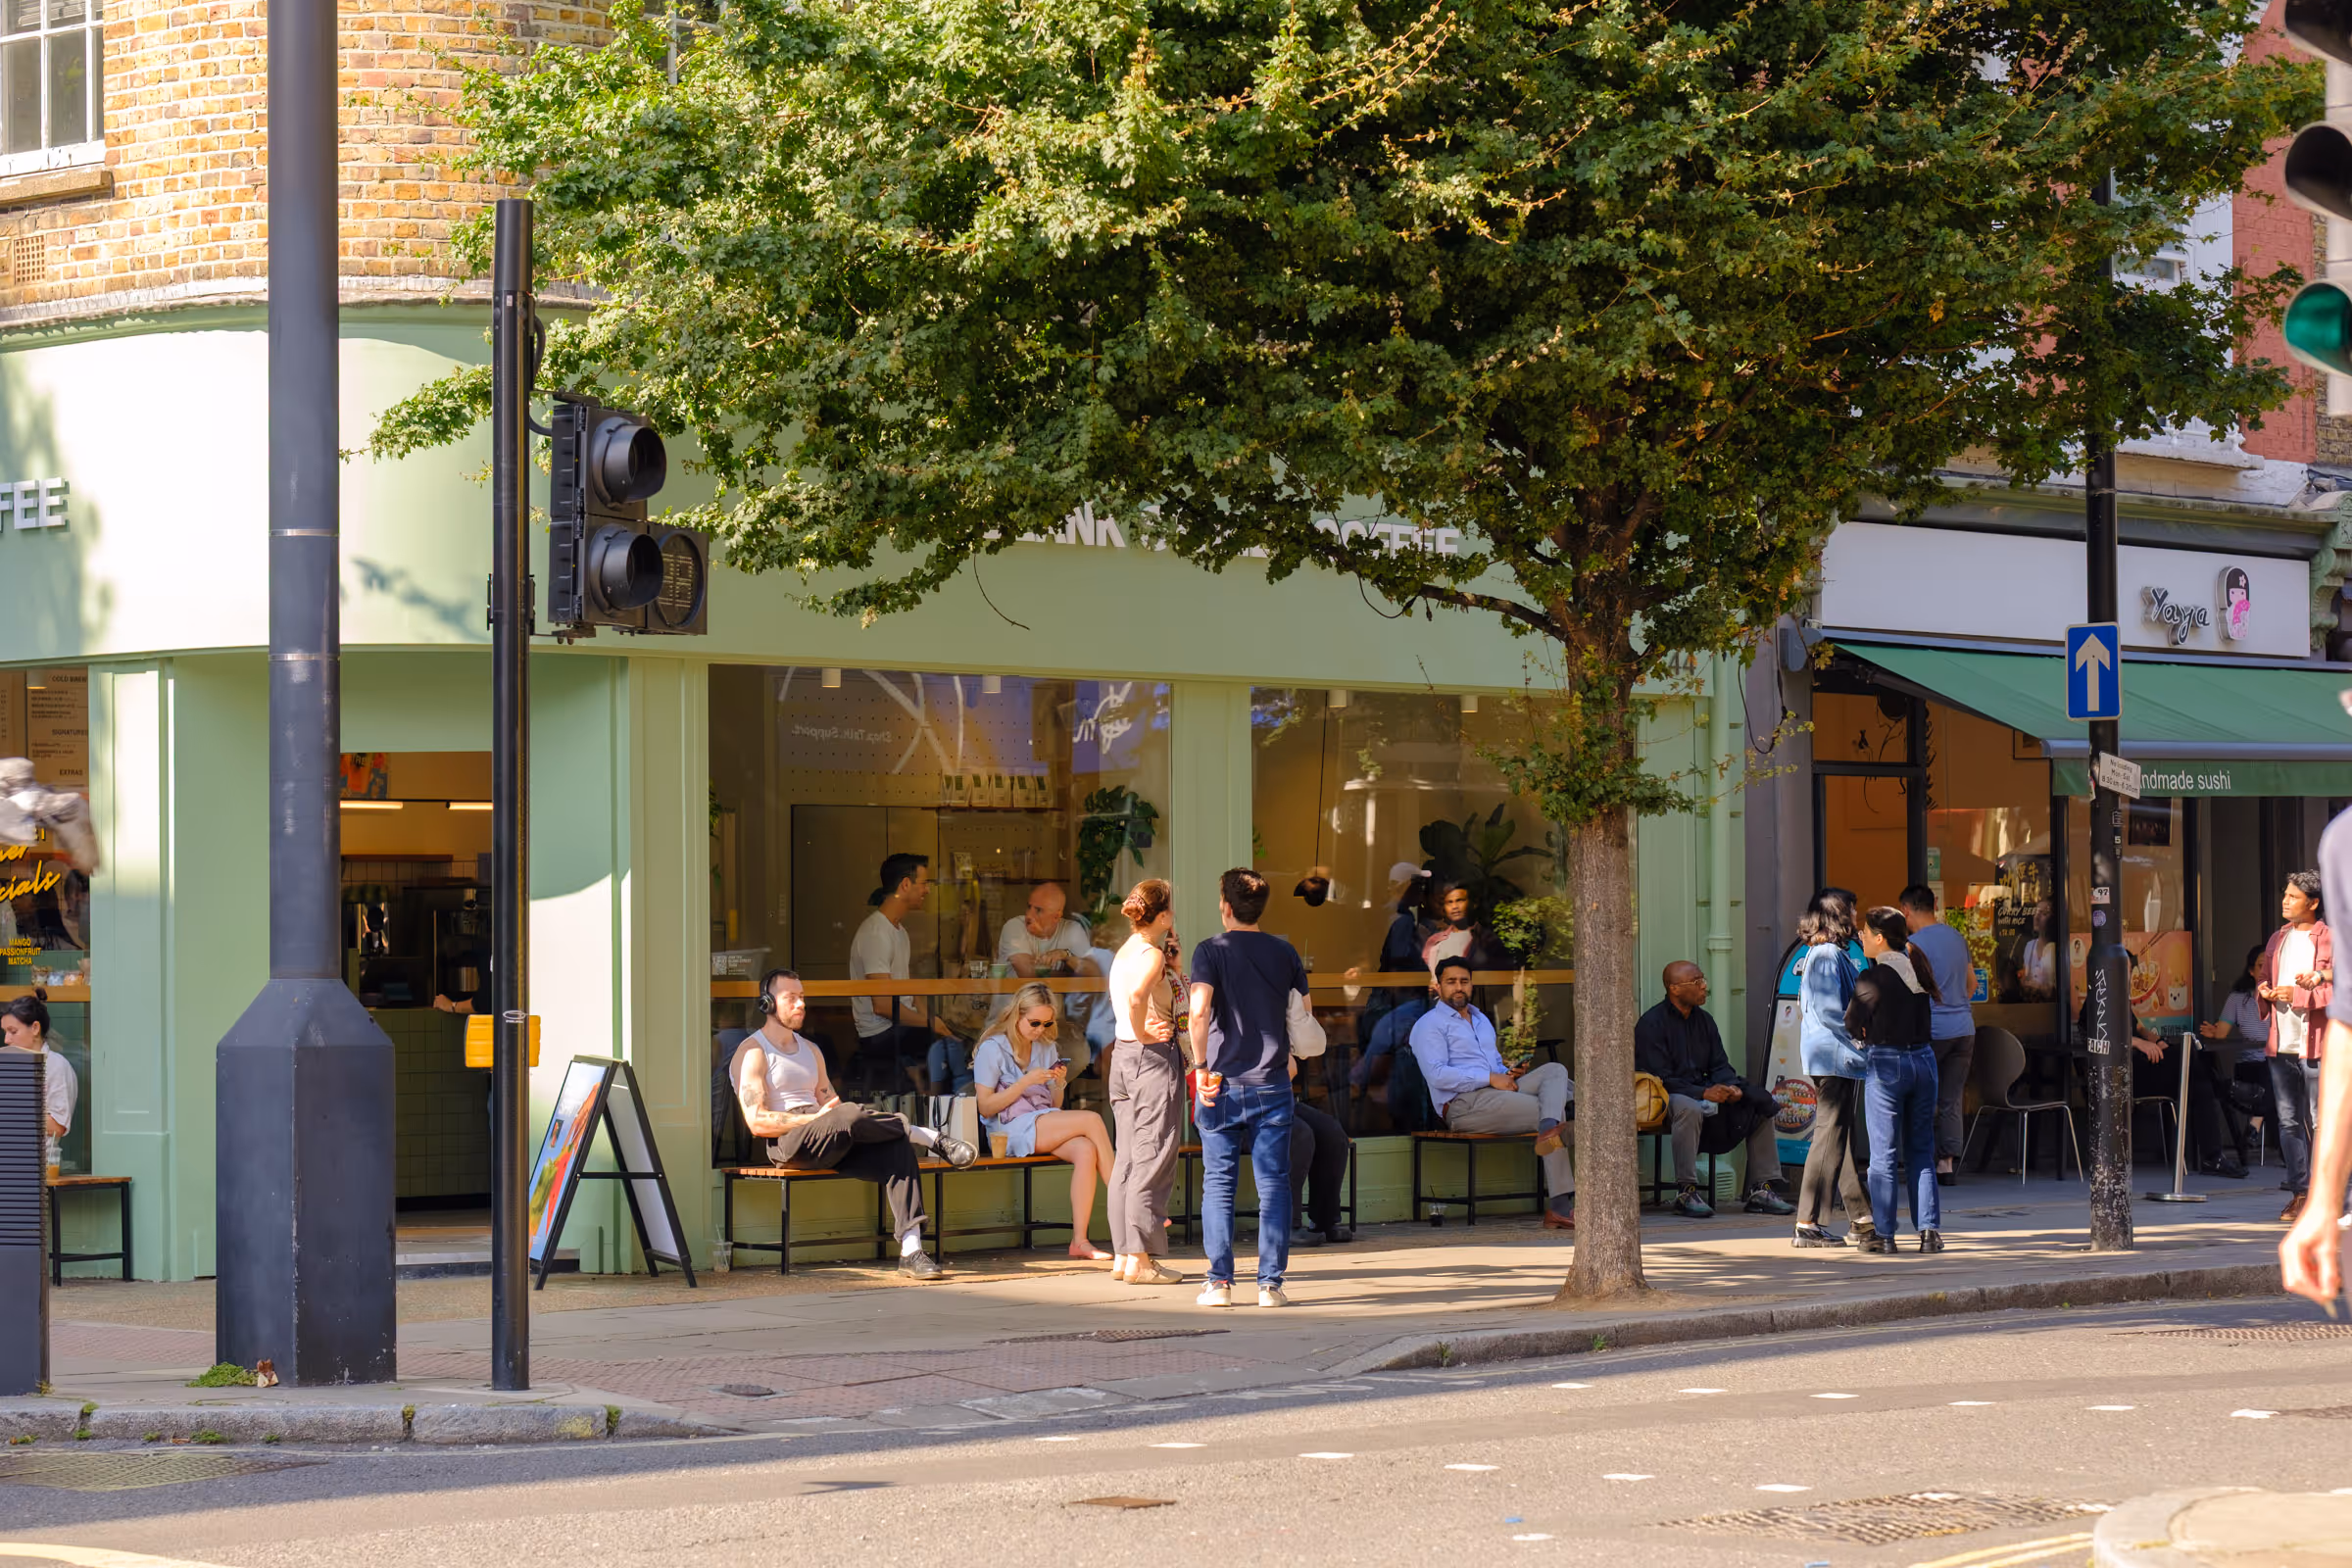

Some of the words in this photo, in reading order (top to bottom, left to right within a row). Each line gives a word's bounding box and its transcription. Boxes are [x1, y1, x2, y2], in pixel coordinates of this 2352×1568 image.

[2149, 587, 2211, 645] Yaya
[2140, 769, 2194, 790] ndmade
[2197, 769, 2231, 790] sushi
[9, 938, 31, 947] MANGO
[0, 947, 42, 956] PASSIONFRUIT
[8, 956, 32, 965] MATCHA
